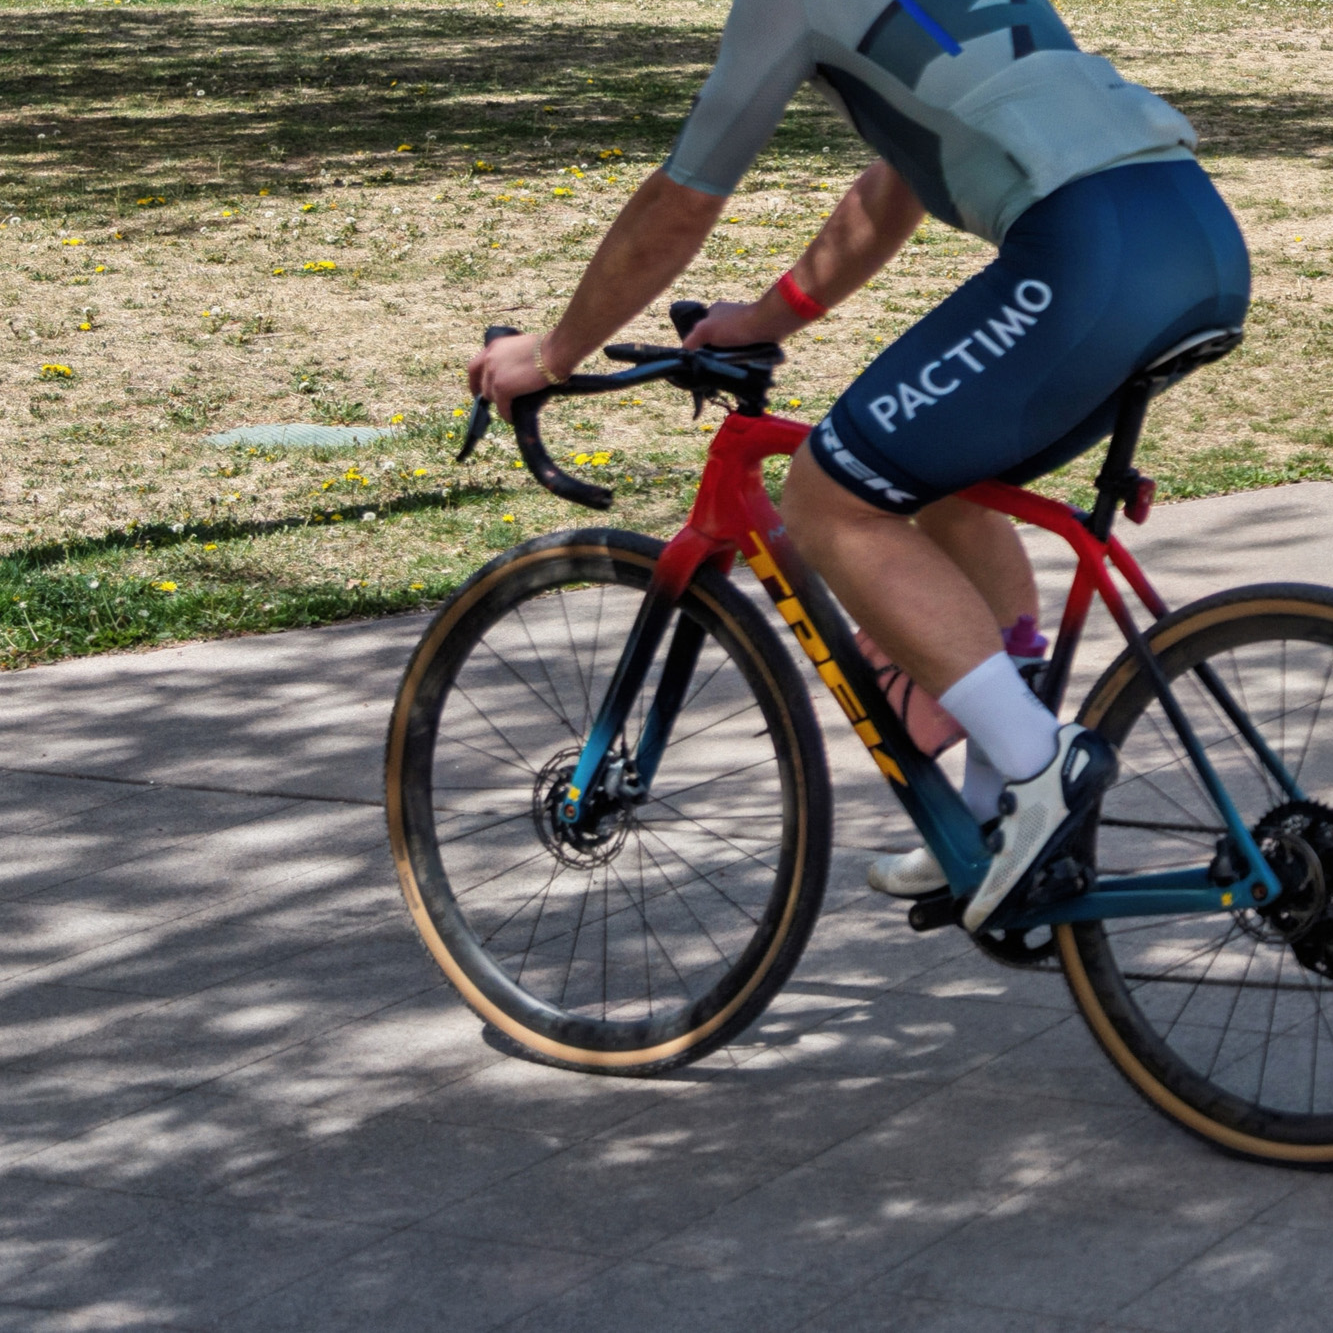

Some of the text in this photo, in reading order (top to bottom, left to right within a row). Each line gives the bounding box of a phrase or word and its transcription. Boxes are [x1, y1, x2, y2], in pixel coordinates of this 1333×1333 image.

[868, 278, 1053, 433] PACTIMO
[820, 416, 919, 504] REK
[747, 530, 908, 787] TREK
